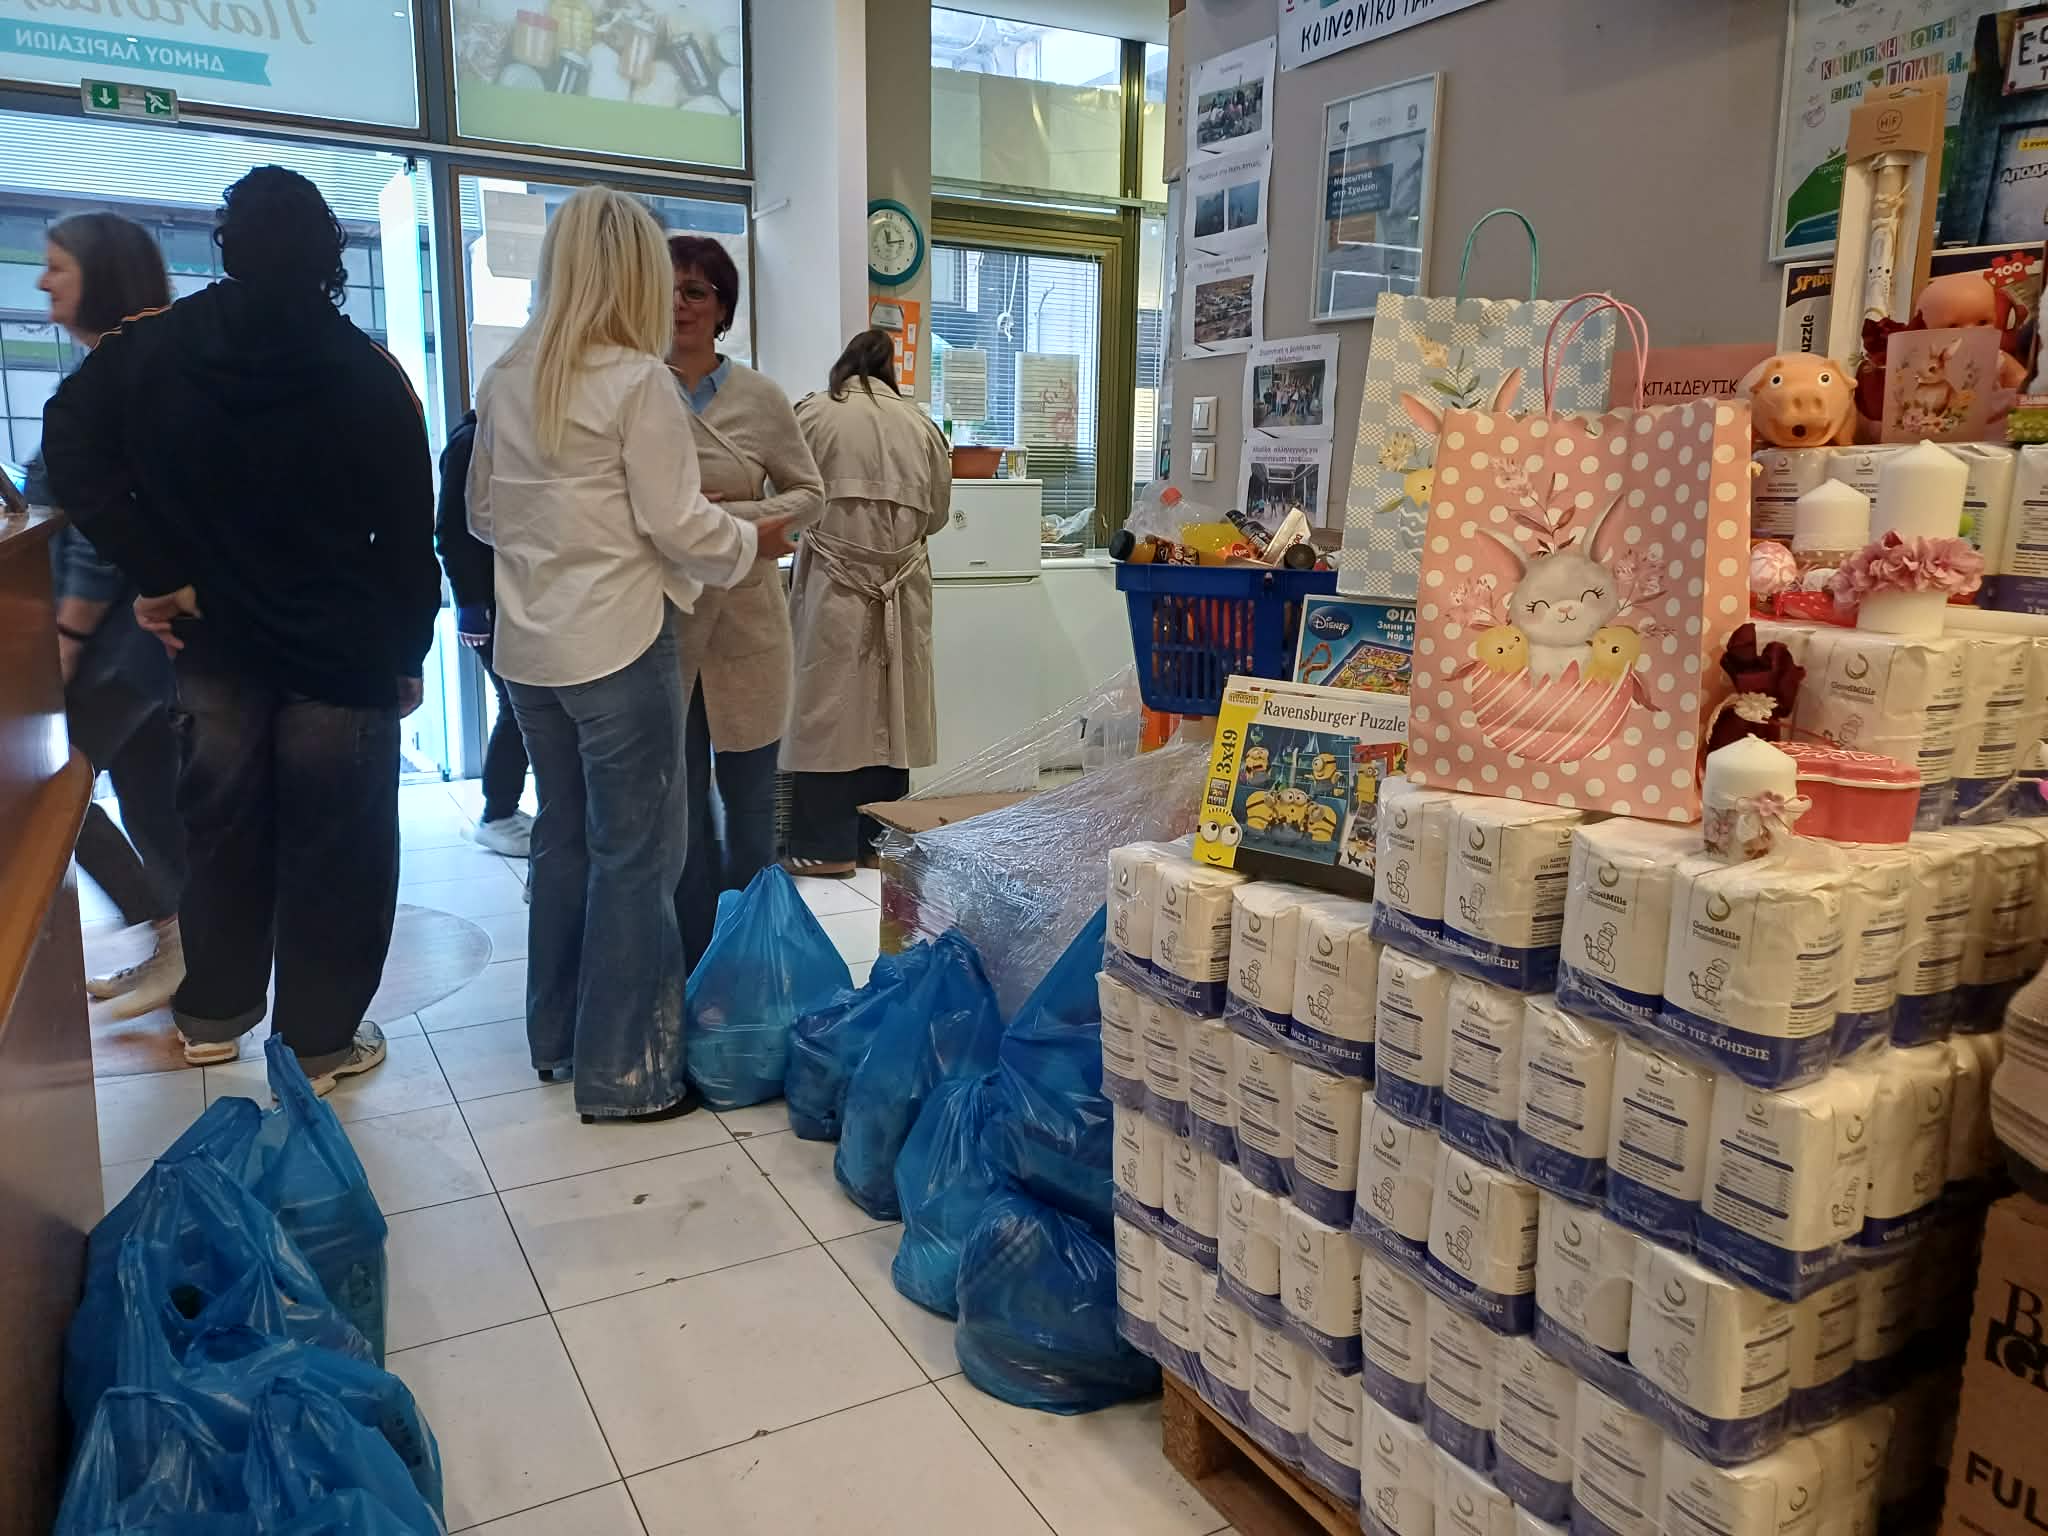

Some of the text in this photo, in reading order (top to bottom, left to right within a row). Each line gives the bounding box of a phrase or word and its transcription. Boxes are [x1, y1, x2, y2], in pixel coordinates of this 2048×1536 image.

[1994, 262, 2023, 276] 100
[1635, 379, 1738, 397] ΚΠΑΙΔΕΥΤΙΚ
[1263, 700, 1406, 733] Ravensburger Puzzle
[1215, 729, 1238, 774] 3x49
[1692, 919, 1742, 942] GoodMills
[1687, 1026, 1709, 1043] ΤΙΣ
[1709, 1033, 1771, 1062] ΧΡΗΣΕΙΣ
